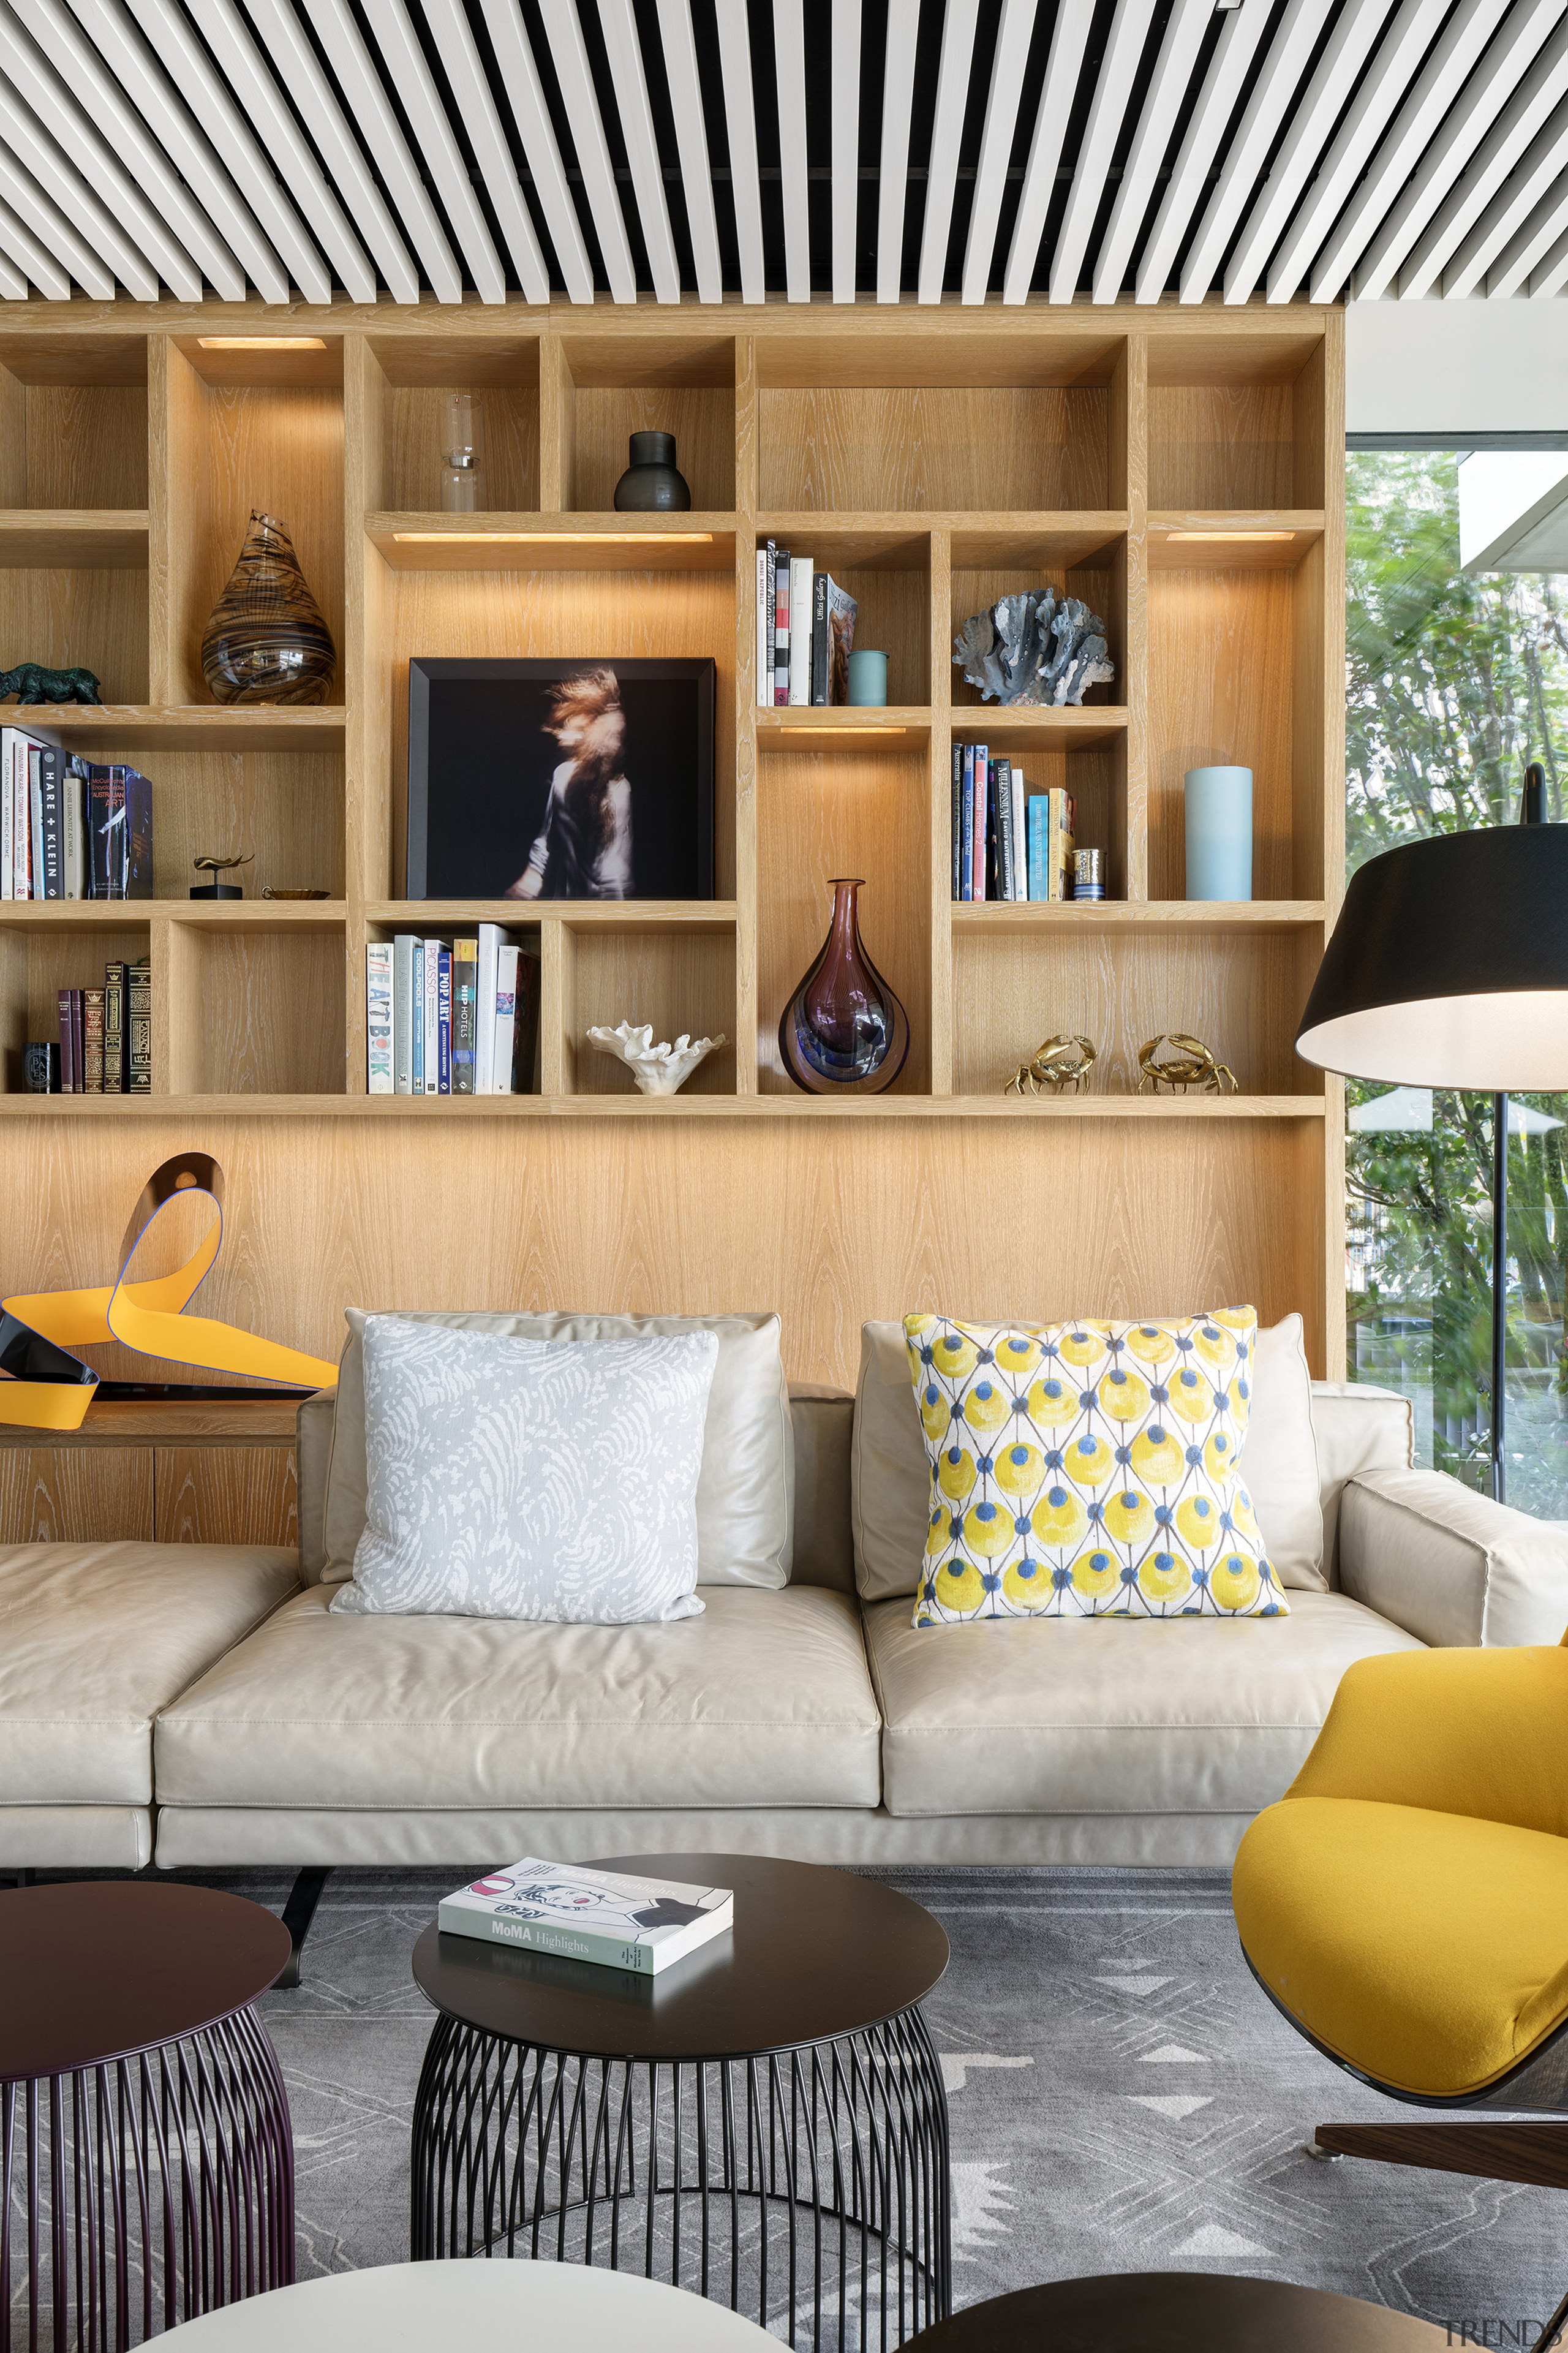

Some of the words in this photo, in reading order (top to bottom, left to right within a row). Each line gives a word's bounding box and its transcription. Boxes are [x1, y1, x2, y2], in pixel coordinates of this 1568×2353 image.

[816, 578, 827, 601] Gallery
[45, 772, 56, 809] HARE
[105, 798, 124, 807] ART
[998, 766, 1010, 819] MILLENNIUM
[47, 834, 58, 877] KLEIN
[369, 947, 391, 984] THE
[426, 948, 437, 994] PICASSO
[439, 972, 450, 997] POP
[369, 988, 391, 1022] ART
[439, 997, 450, 1022] ART
[369, 1025, 391, 1077] BOOK
[398, 1044, 408, 1072] YEARS
[610, 1878, 678, 1896] Highlights
[492, 1921, 532, 1941] MoMA
[535, 1931, 589, 1953] Highlights
